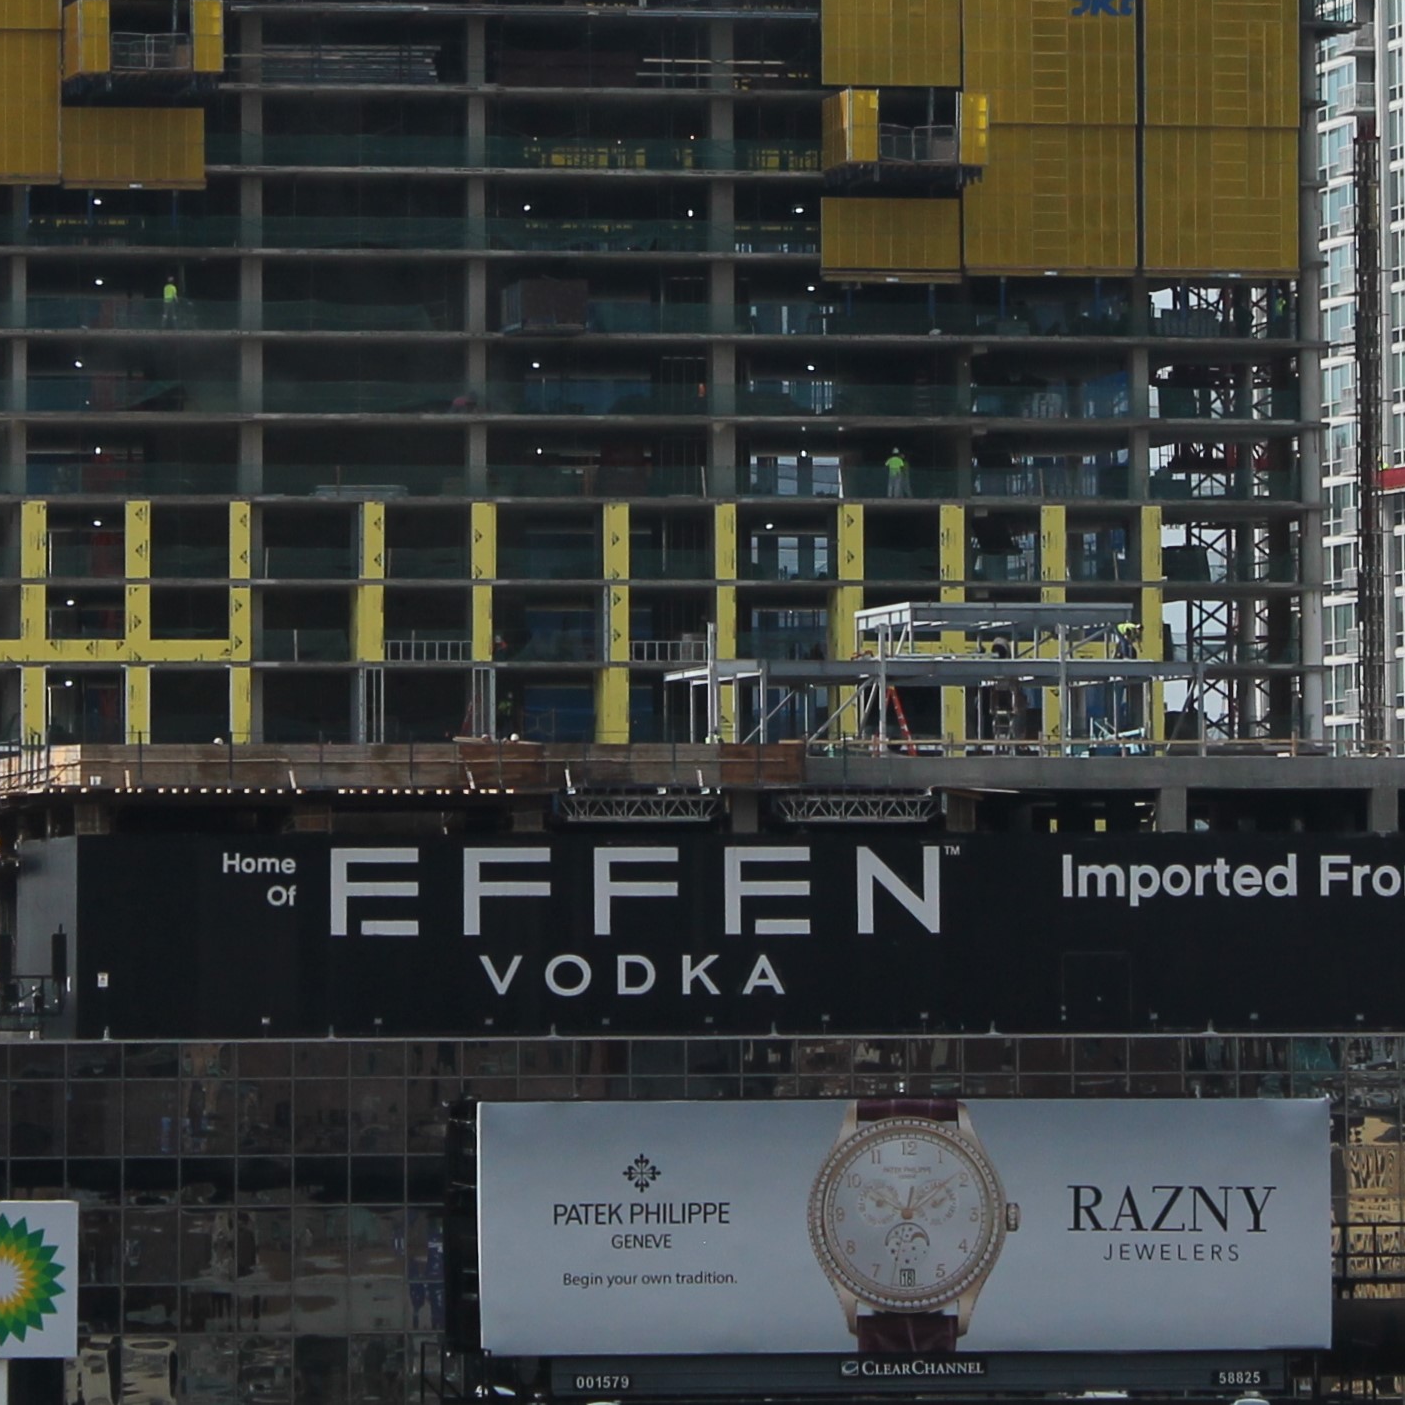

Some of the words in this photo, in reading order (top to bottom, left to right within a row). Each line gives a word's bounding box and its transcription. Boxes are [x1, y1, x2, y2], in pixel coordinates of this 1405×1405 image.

[222, 852, 296, 874] Home
[330, 846, 940, 936] EFFEN
[1061, 853, 1298, 907] Imported
[266, 885, 297, 907] Of
[479, 954, 786, 997] VODKA
[901, 1141, 918, 1156] 12
[554, 1203, 623, 1225] PATEK
[630, 1202, 730, 1224] PHILIPPE
[1067, 1185, 1277, 1233] RAZNY
[611, 1233, 672, 1249] GENEVE
[1103, 1243, 1239, 1261] JEWELERS
[563, 1272, 603, 1289] Begin
[607, 1274, 638, 1288] your
[641, 1273, 672, 1284] own
[676, 1271, 738, 1284] tradition.
[576, 1375, 630, 1389] 001579
[1219, 1371, 1261, 1384] 58825
